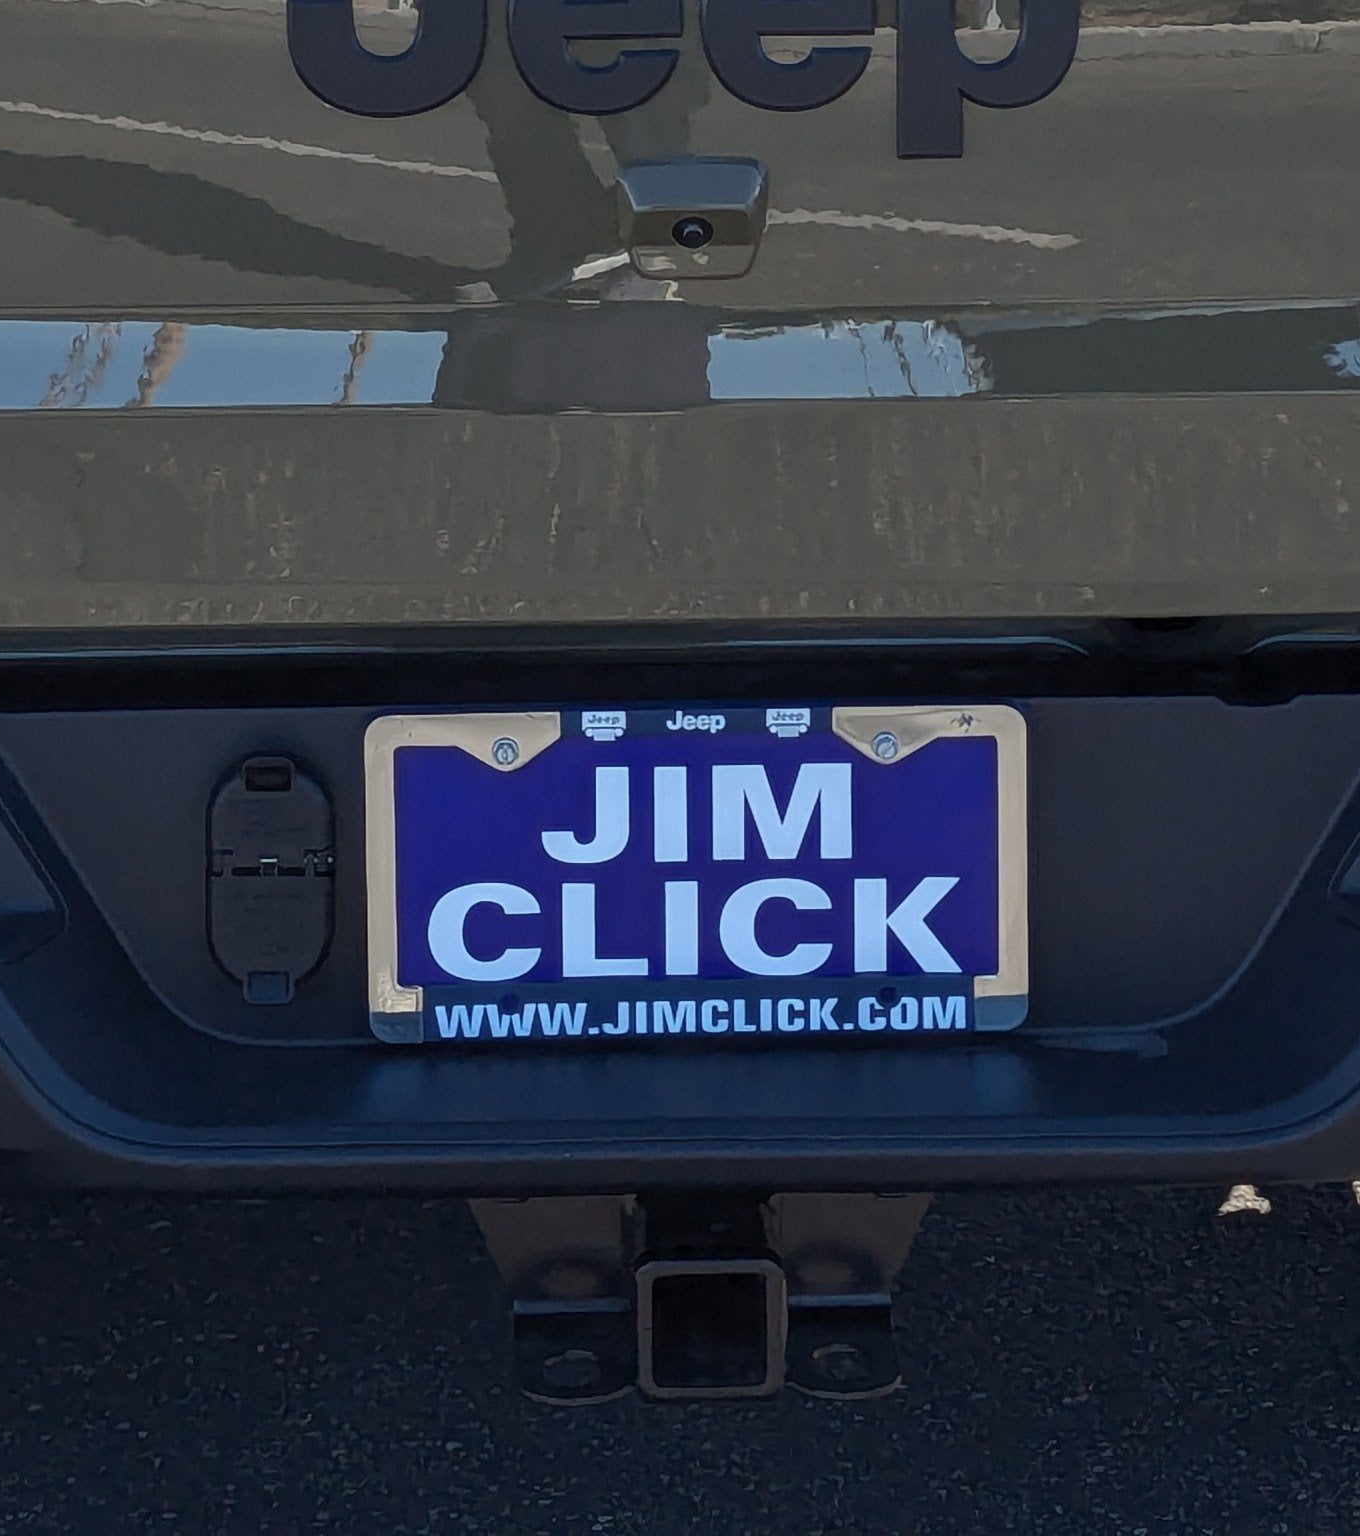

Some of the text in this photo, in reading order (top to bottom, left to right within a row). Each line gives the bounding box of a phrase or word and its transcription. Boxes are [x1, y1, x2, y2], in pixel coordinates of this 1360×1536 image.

[587, 713, 620, 725] Jeep
[666, 710, 726, 734] Jeep
[771, 710, 805, 722] Jeep
[541, 762, 853, 864] JIM
[426, 876, 962, 982] CLICK
[434, 995, 967, 1039] WWW.JIMCLICK.COM
